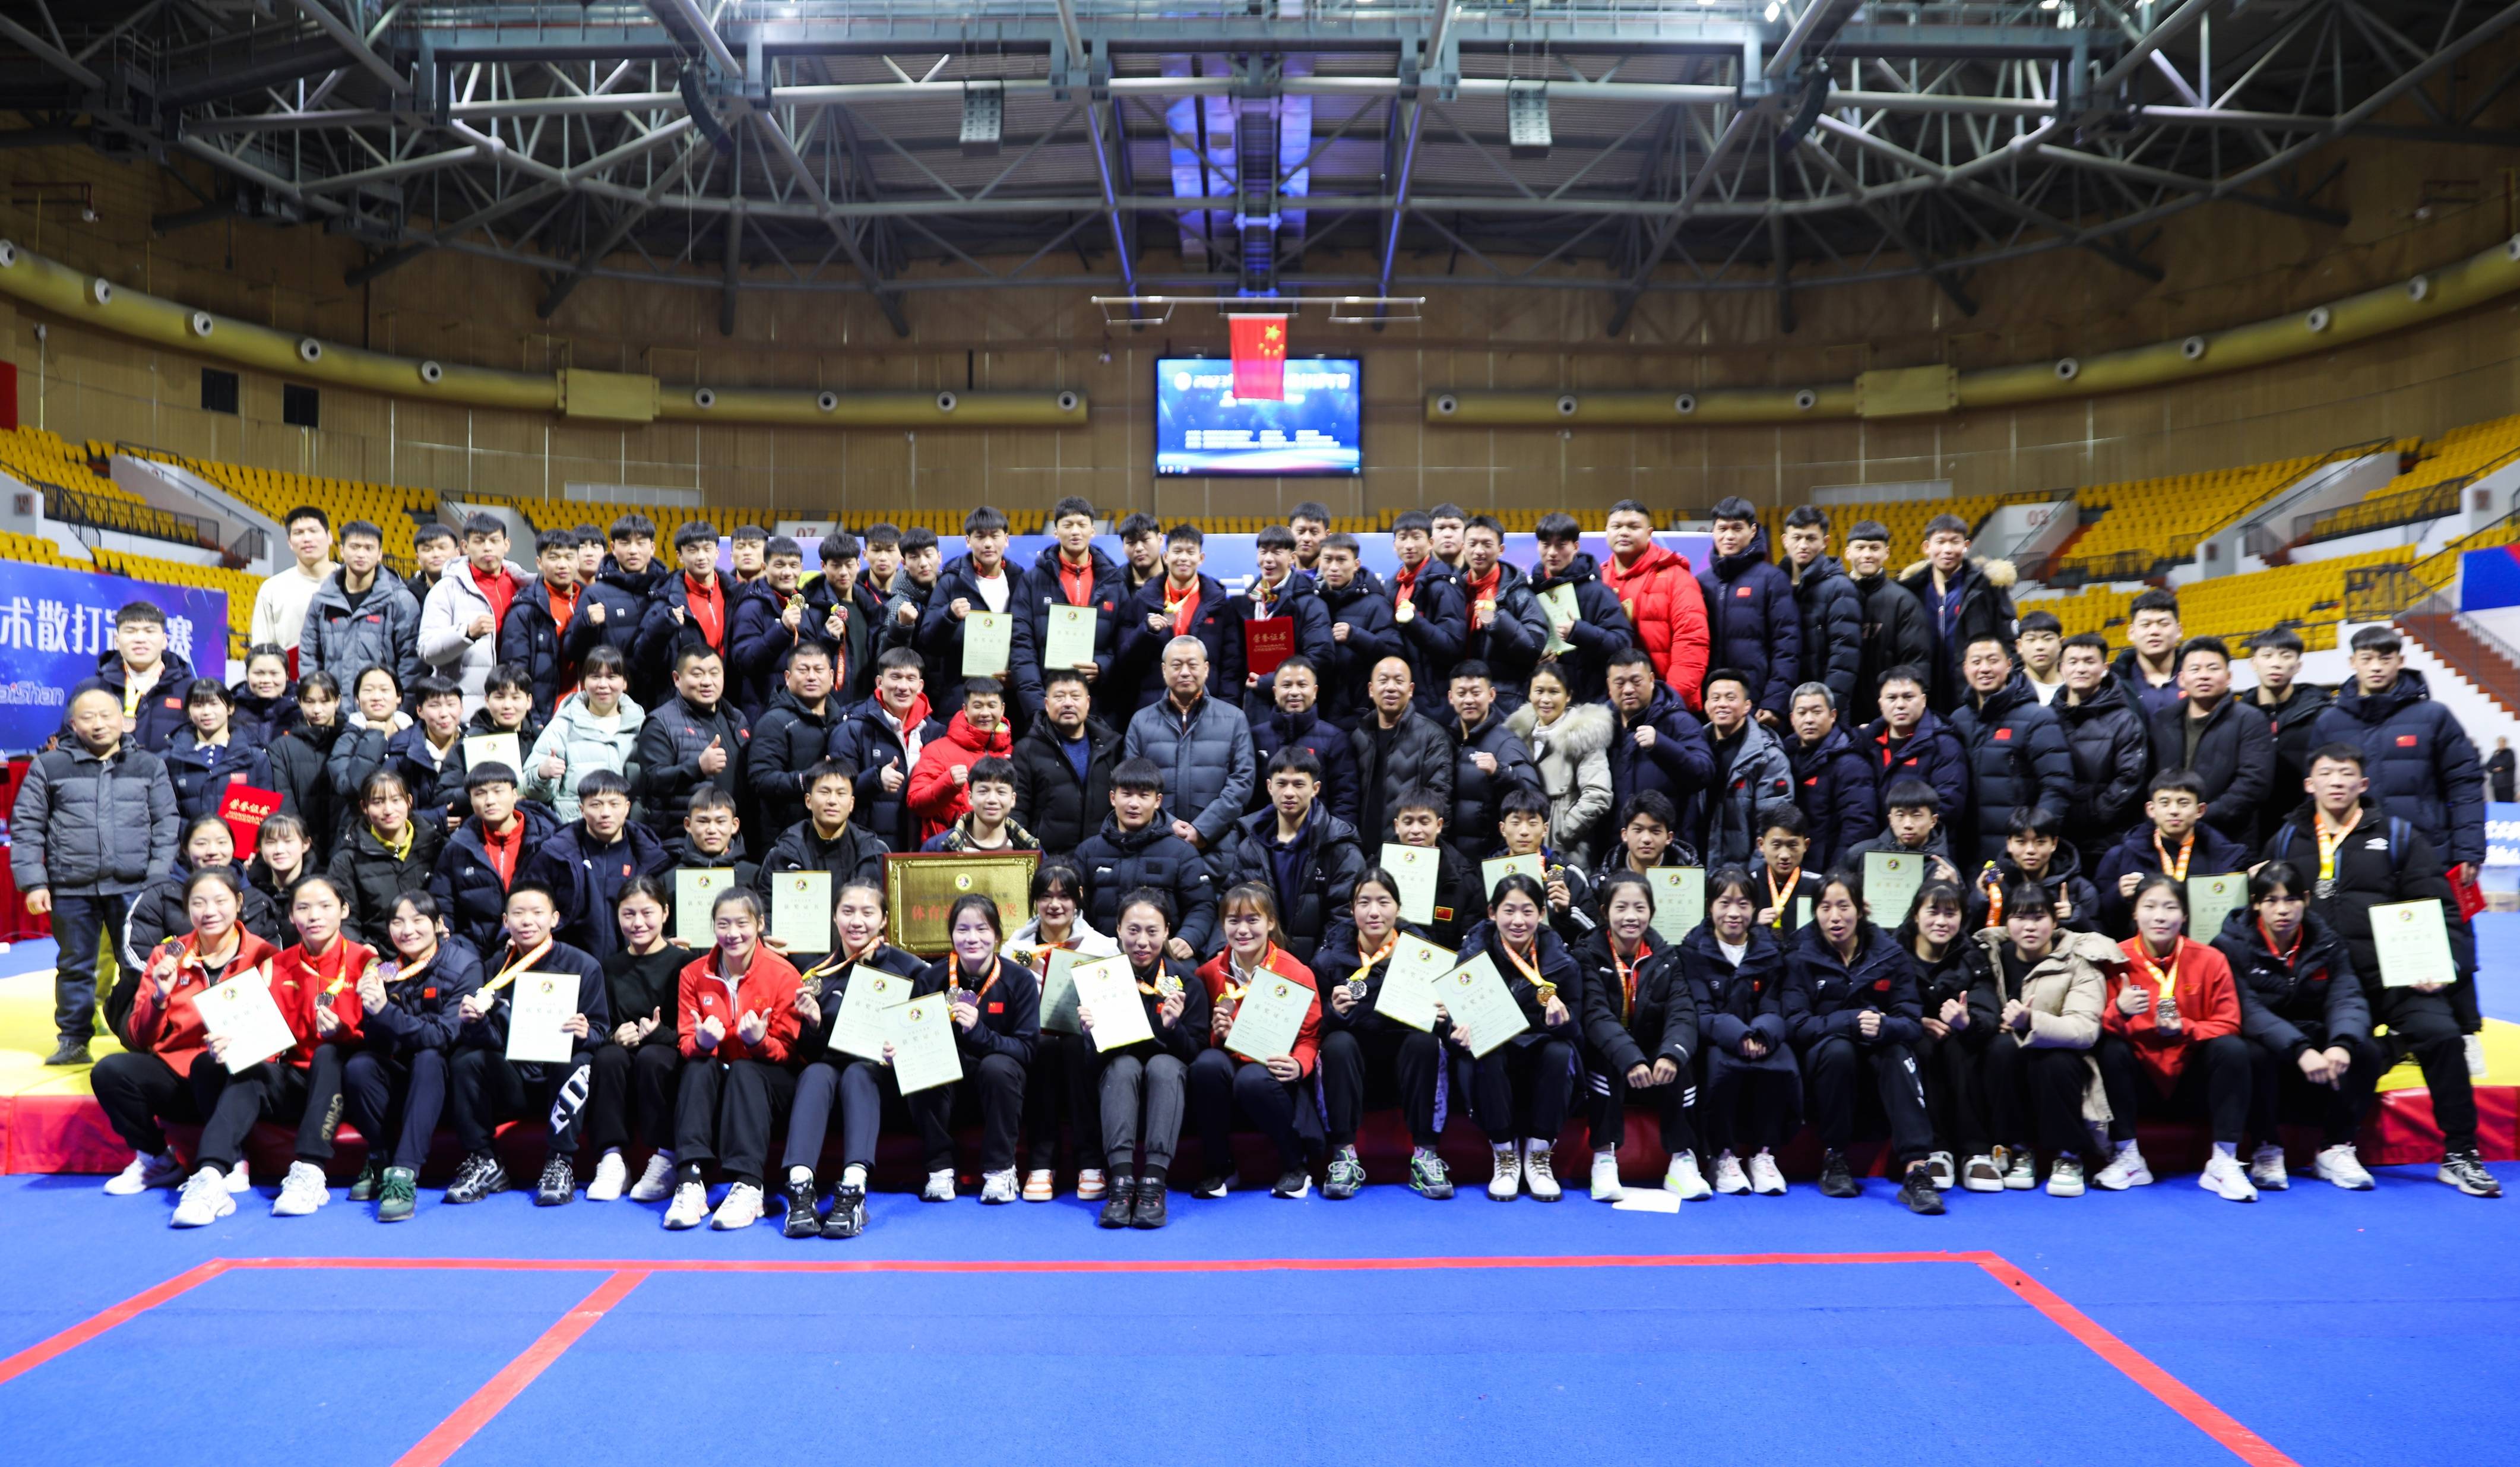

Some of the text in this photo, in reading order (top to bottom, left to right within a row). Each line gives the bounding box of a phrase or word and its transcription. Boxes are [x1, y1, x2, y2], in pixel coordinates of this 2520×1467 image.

[0, 596, 194, 663] 术散打赛
[321, 1093, 343, 1140] CHINA
